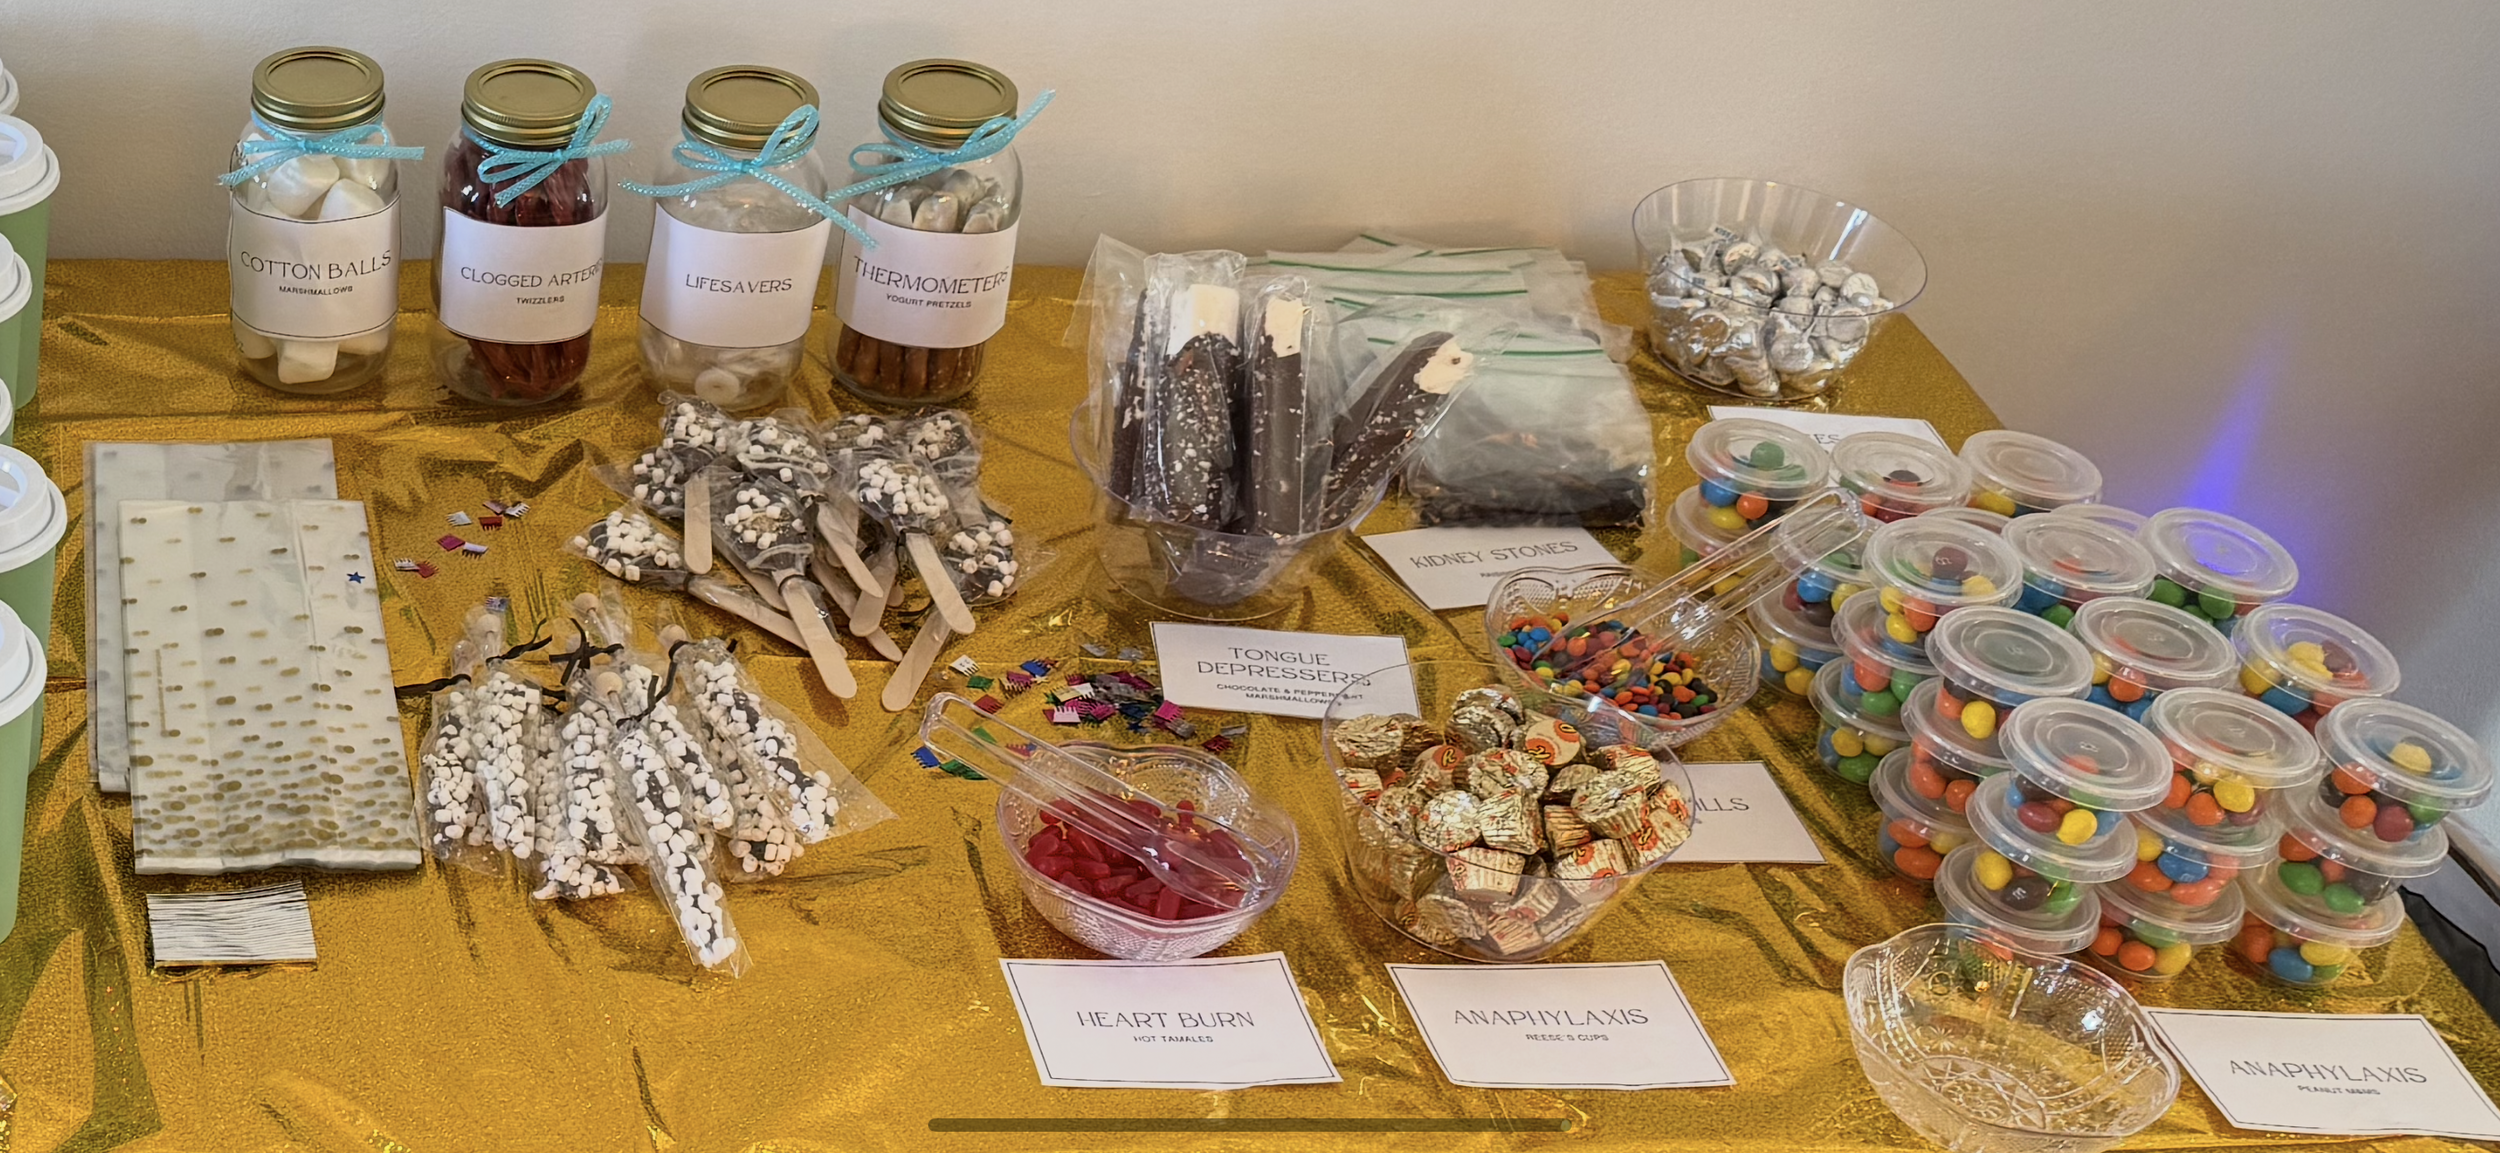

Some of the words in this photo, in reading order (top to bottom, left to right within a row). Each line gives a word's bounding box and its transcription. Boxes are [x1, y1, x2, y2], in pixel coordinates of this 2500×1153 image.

[240, 250, 321, 280] COTTON
[328, 249, 392, 280] BALLS
[460, 266, 543, 288] CLOGGED
[685, 273, 793, 294] LIFESAVERS
[853, 255, 1010, 294] THERMOMETERS
[279, 285, 353, 296] MARSHMALLOWS
[516, 295, 565, 305] TWIZZLERS
[886, 292, 924, 307] YOGURT
[926, 299, 972, 309] PRETZELS
[1409, 549, 1484, 569] KIDNEY
[1490, 540, 1579, 561] STONES
[1228, 646, 1331, 666] TONGUE
[1196, 660, 1372, 687] DEPRESSERS
[1216, 683, 1281, 694] CHOCOLATE
[1076, 1011, 1167, 1028] HEART
[1178, 1011, 1255, 1028] BURN
[1453, 1008, 1649, 1026] ANAPHYLAXIS
[1133, 1035, 1157, 1043] HOT
[1161, 1035, 1214, 1043] TAMALES
[1525, 1033, 1576, 1042] REESE'S
[1577, 1033, 1609, 1042] CUPS
[2229, 1059, 2428, 1084] ANAPHYLAXIS
